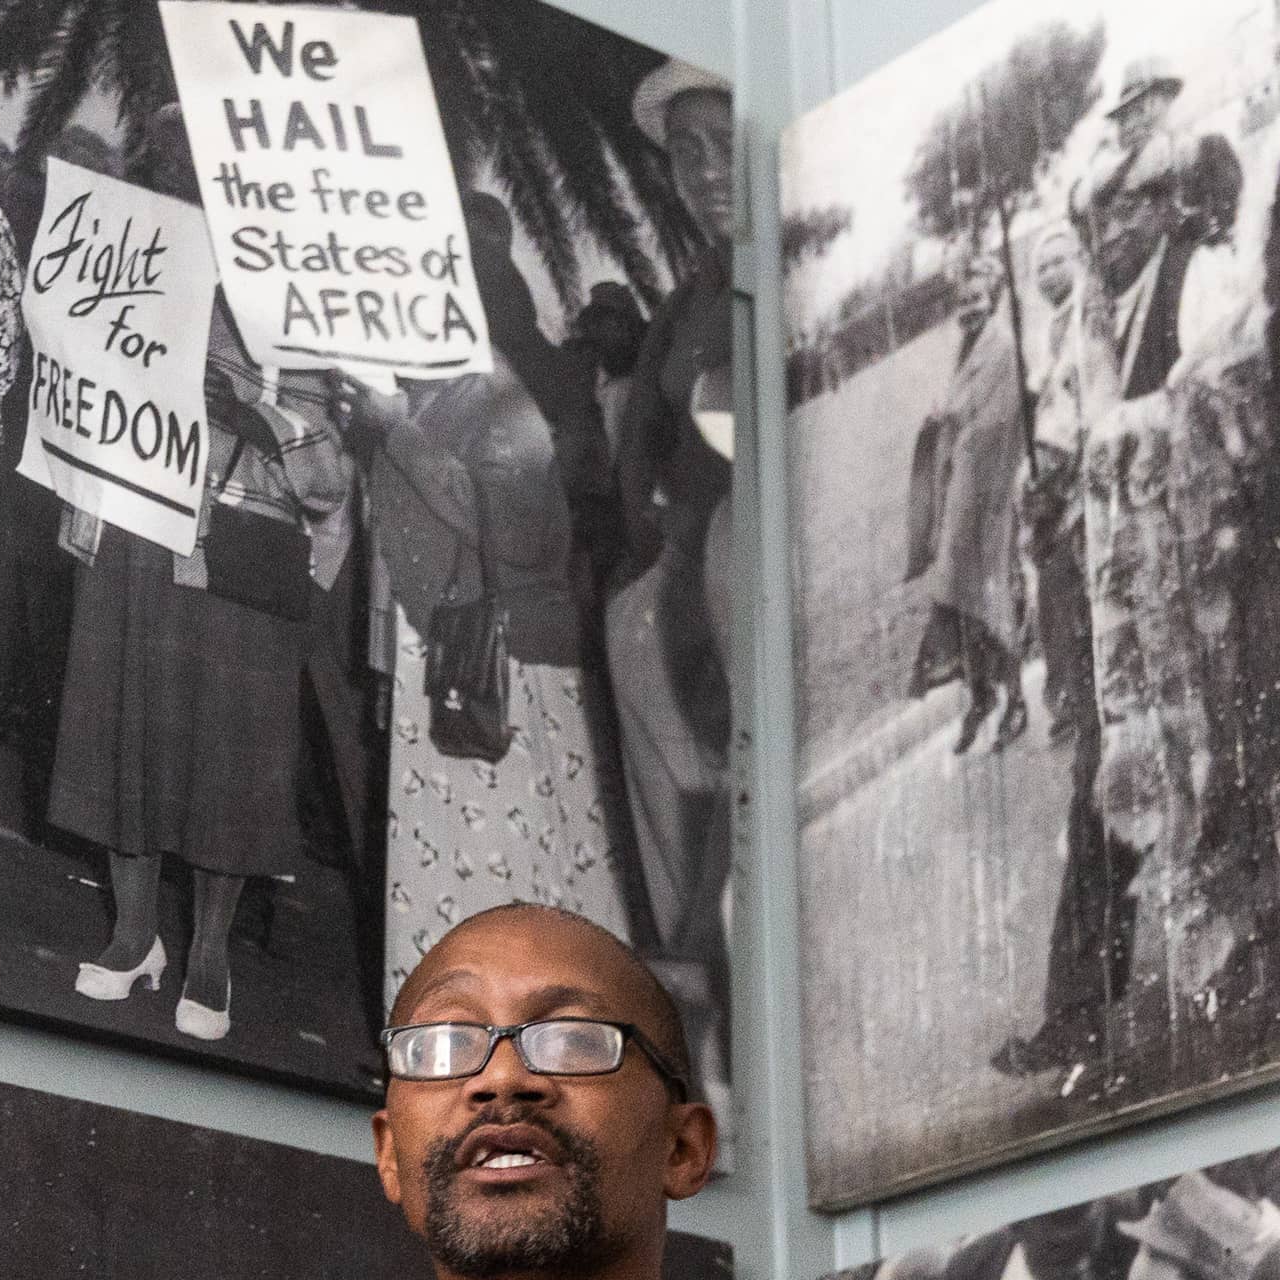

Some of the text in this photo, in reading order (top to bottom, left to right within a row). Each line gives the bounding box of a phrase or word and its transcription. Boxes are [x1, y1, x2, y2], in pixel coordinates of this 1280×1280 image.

[228, 18, 339, 81] We
[222, 98, 403, 160] HAIL
[212, 162, 430, 221] the free
[32, 190, 169, 318] Fight
[231, 225, 467, 286] States of
[104, 304, 169, 370] for
[283, 281, 478, 345] AFRICA
[31, 351, 203, 488] FREEDOM
